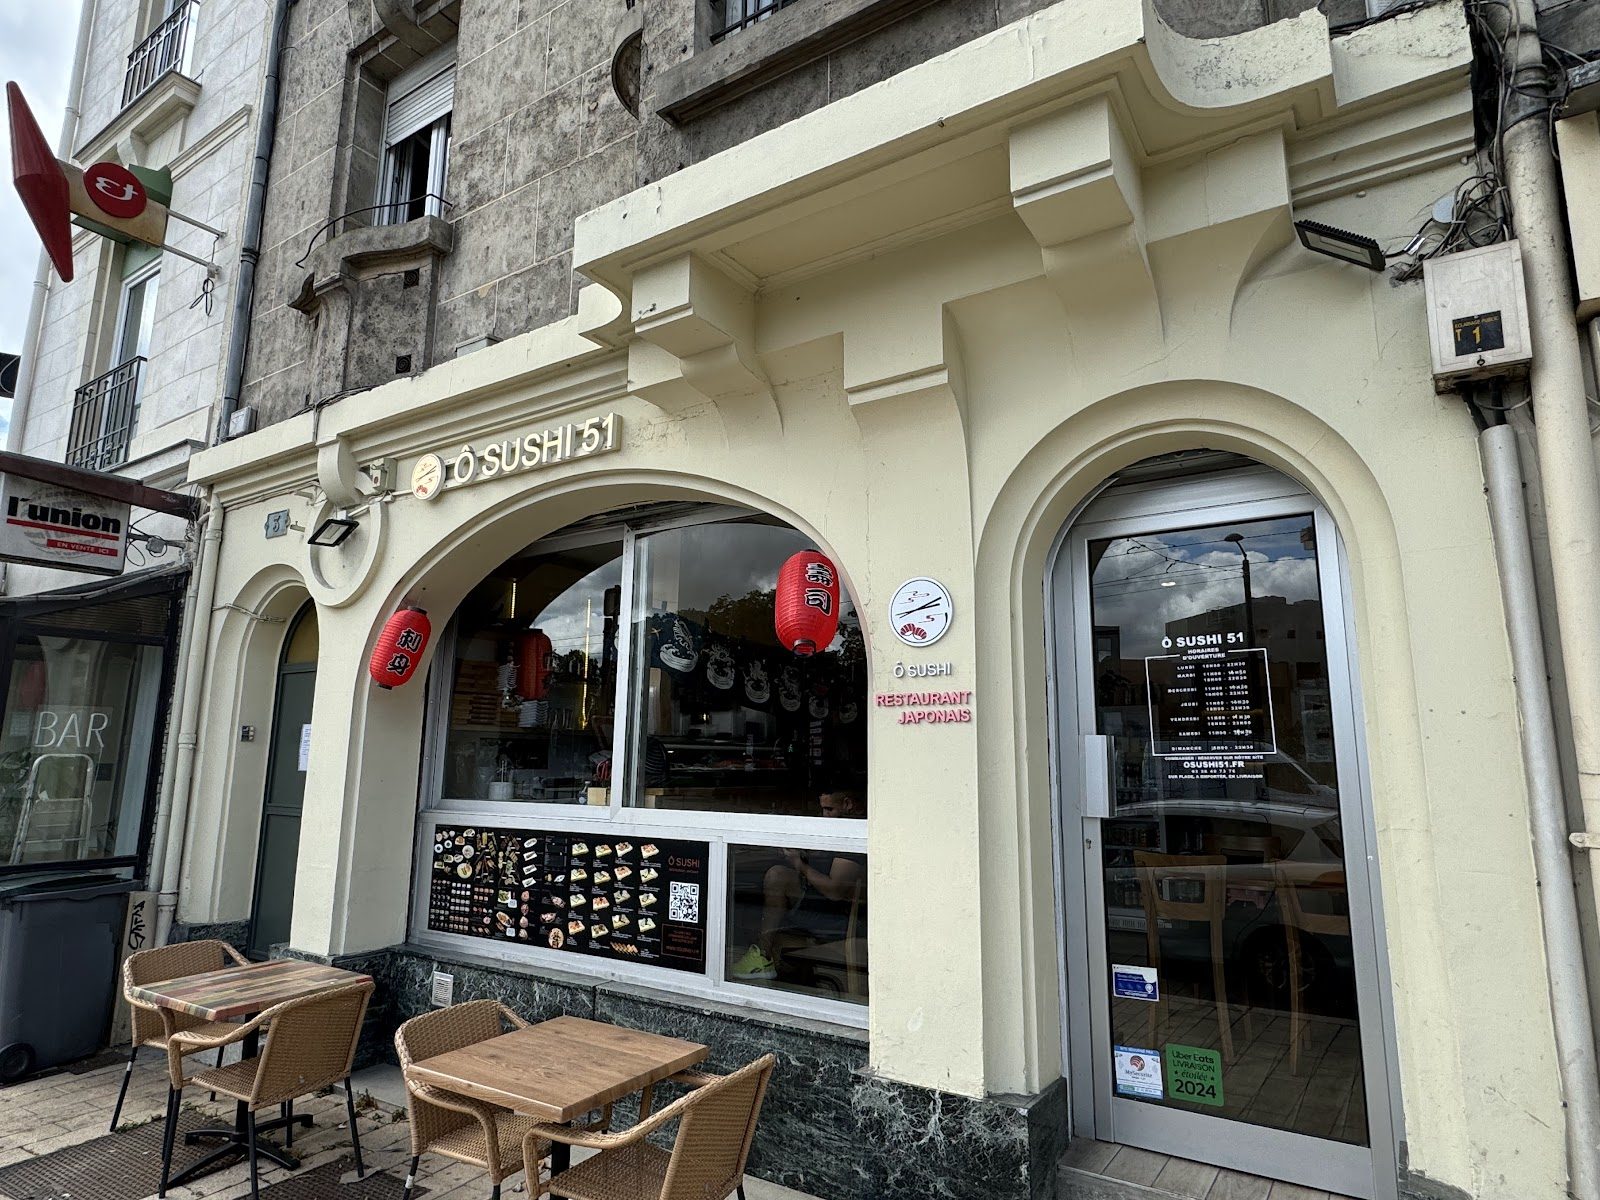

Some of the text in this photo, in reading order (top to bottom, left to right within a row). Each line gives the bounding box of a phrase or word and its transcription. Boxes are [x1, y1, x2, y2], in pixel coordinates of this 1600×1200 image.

[1455, 326, 1480, 344] T 1
[454, 412, 615, 483] Ô SUSHI 51
[56, 541, 69, 549] EN
[71, 543, 95, 552] VENTE
[1161, 632, 1243, 648] Ô SUSHI 51
[386, 627, 423, 676] 刺身
[893, 661, 952, 678] Ô SUSHI
[875, 690, 972, 706] RESTAURANT
[898, 709, 971, 724] JAPONAIS
[34, 711, 108, 748] BAR
[676, 857, 700, 868] SUSHI
[1172, 1050, 1214, 1064] Uber Eats
[1172, 1059, 1215, 1072] LIVRAISON
[1174, 1079, 1216, 1099] 2024
